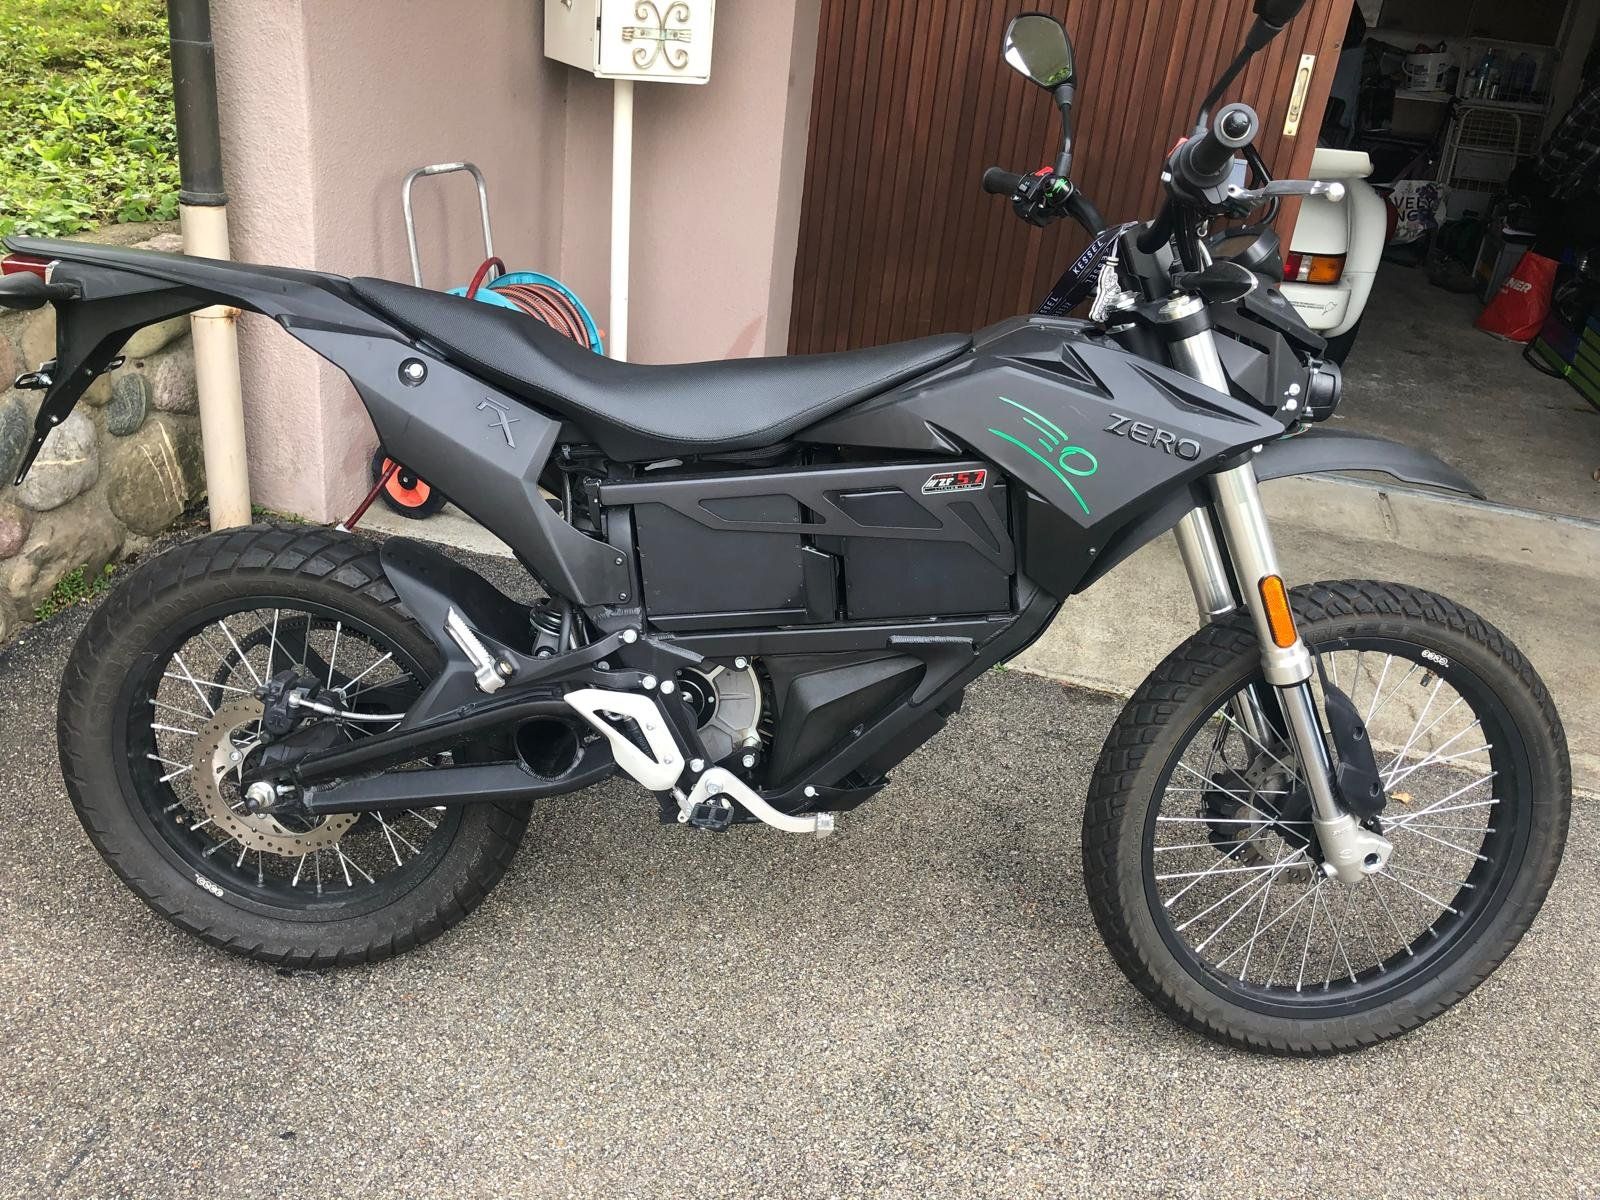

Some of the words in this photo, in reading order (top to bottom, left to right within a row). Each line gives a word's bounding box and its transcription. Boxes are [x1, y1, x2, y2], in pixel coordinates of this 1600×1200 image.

[1393, 197, 1433, 209] VELY
[1072, 240, 1104, 275] KESSEL
[1506, 277, 1533, 293] NER
[1102, 413, 1202, 462] ZERO
